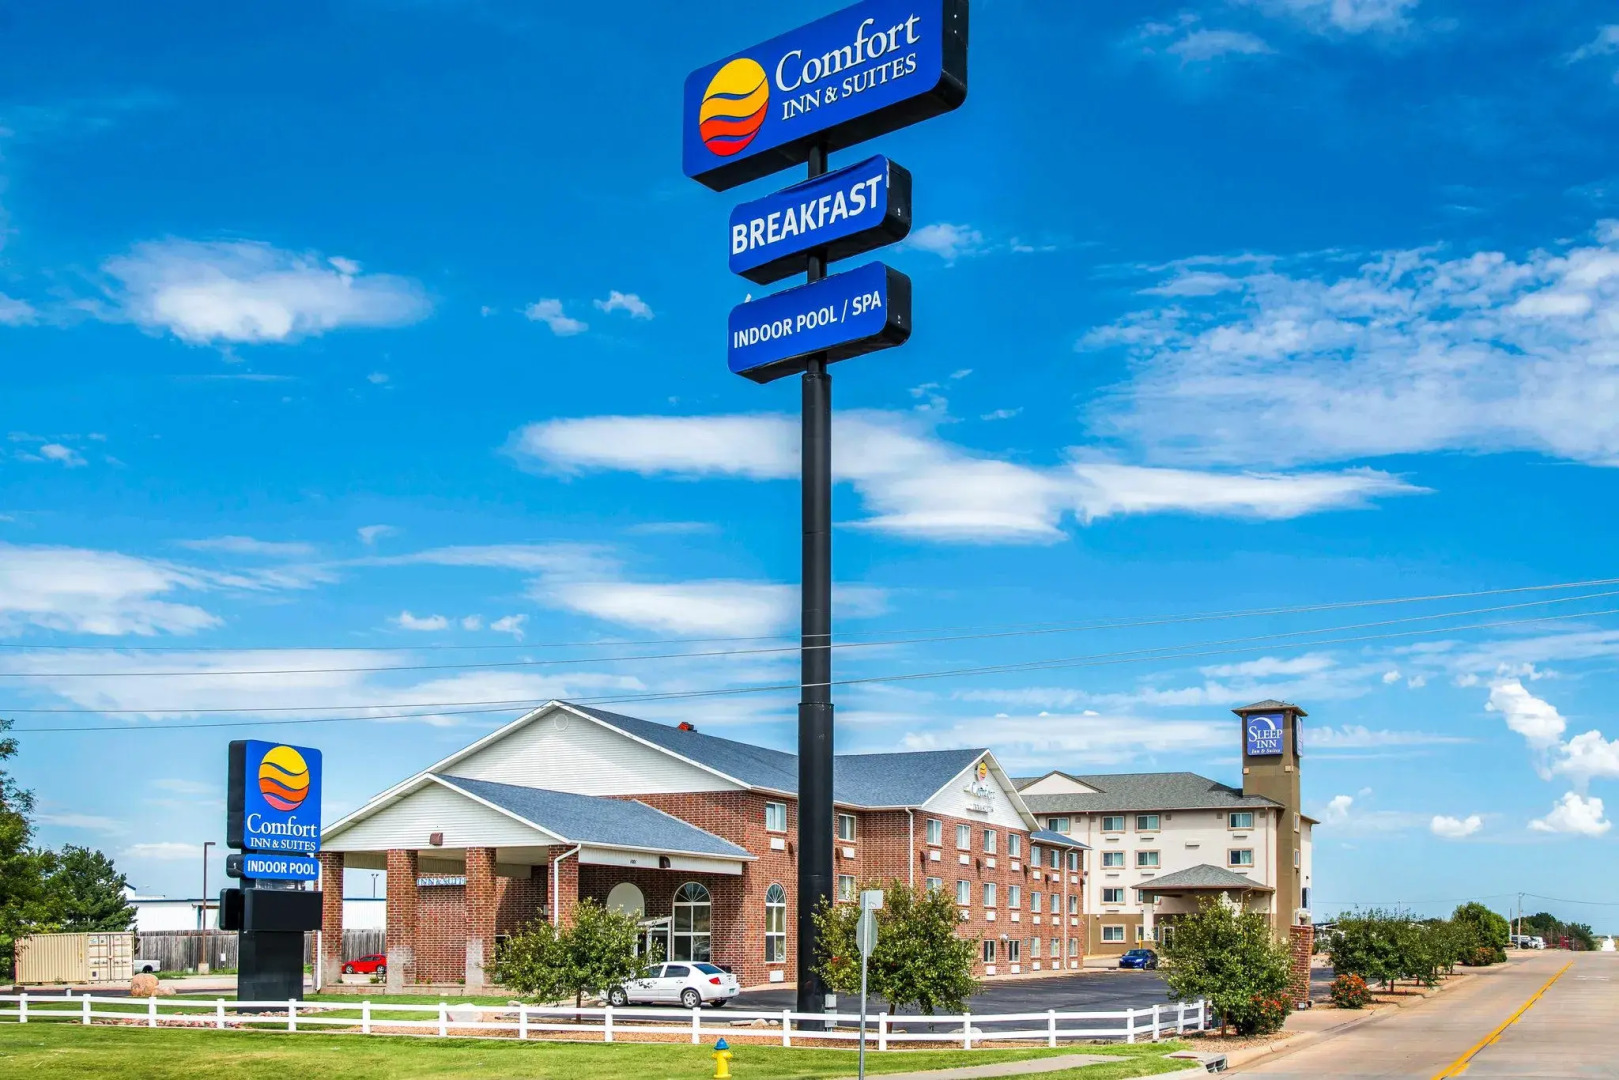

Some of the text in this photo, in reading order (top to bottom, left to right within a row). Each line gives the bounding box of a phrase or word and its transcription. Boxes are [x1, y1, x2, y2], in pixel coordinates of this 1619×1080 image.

[775, 13, 921, 92] Comfort
[781, 53, 917, 121] INN & SUITES
[732, 174, 882, 256] BREAKFAST
[733, 290, 881, 348] INDOOR POOL / SPA
[1256, 740, 1277, 748] INN
[247, 813, 318, 838] Comfort
[250, 837, 316, 851] INN & SUITES
[247, 860, 316, 875] INDOOR POOL
